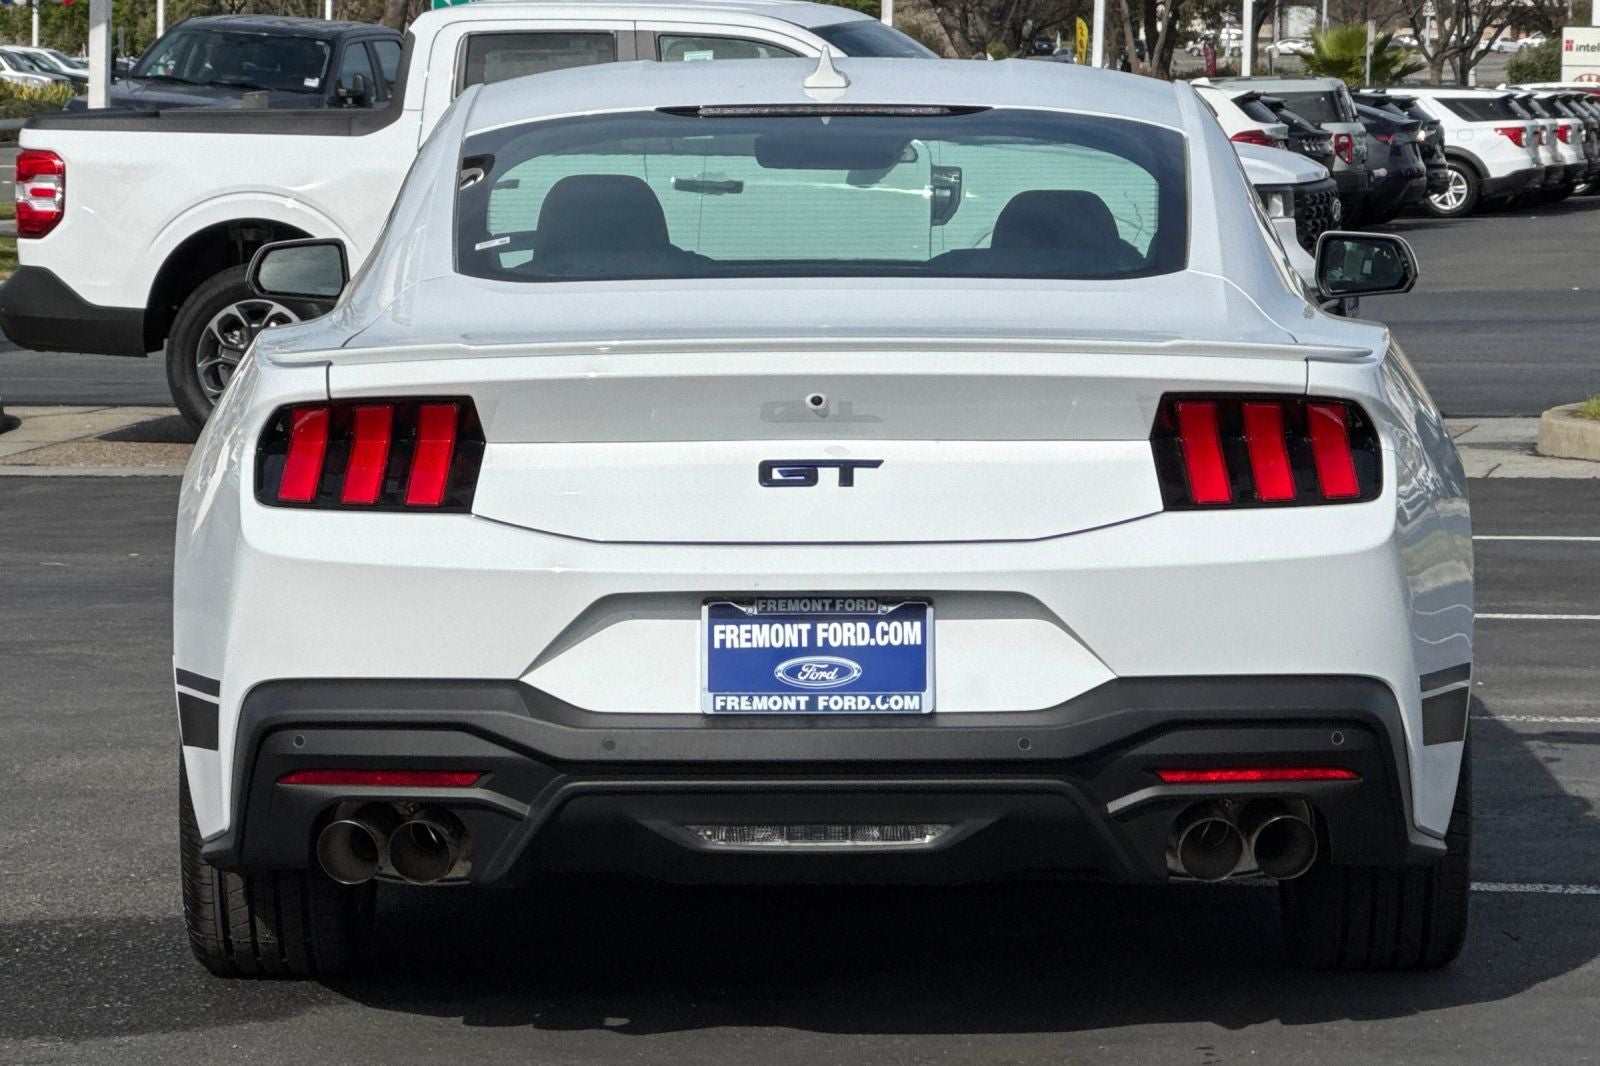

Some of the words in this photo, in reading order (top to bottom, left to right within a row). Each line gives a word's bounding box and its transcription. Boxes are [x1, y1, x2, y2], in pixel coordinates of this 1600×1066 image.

[758, 459, 884, 487] GT
[757, 599, 832, 612] FREMONT
[835, 599, 877, 612] FORD
[713, 623, 811, 649] FREMONT
[816, 621, 922, 647] FORD.COM
[797, 663, 837, 681] Ford
[715, 695, 809, 711] FREMONT
[817, 695, 920, 711] FORD.COM
